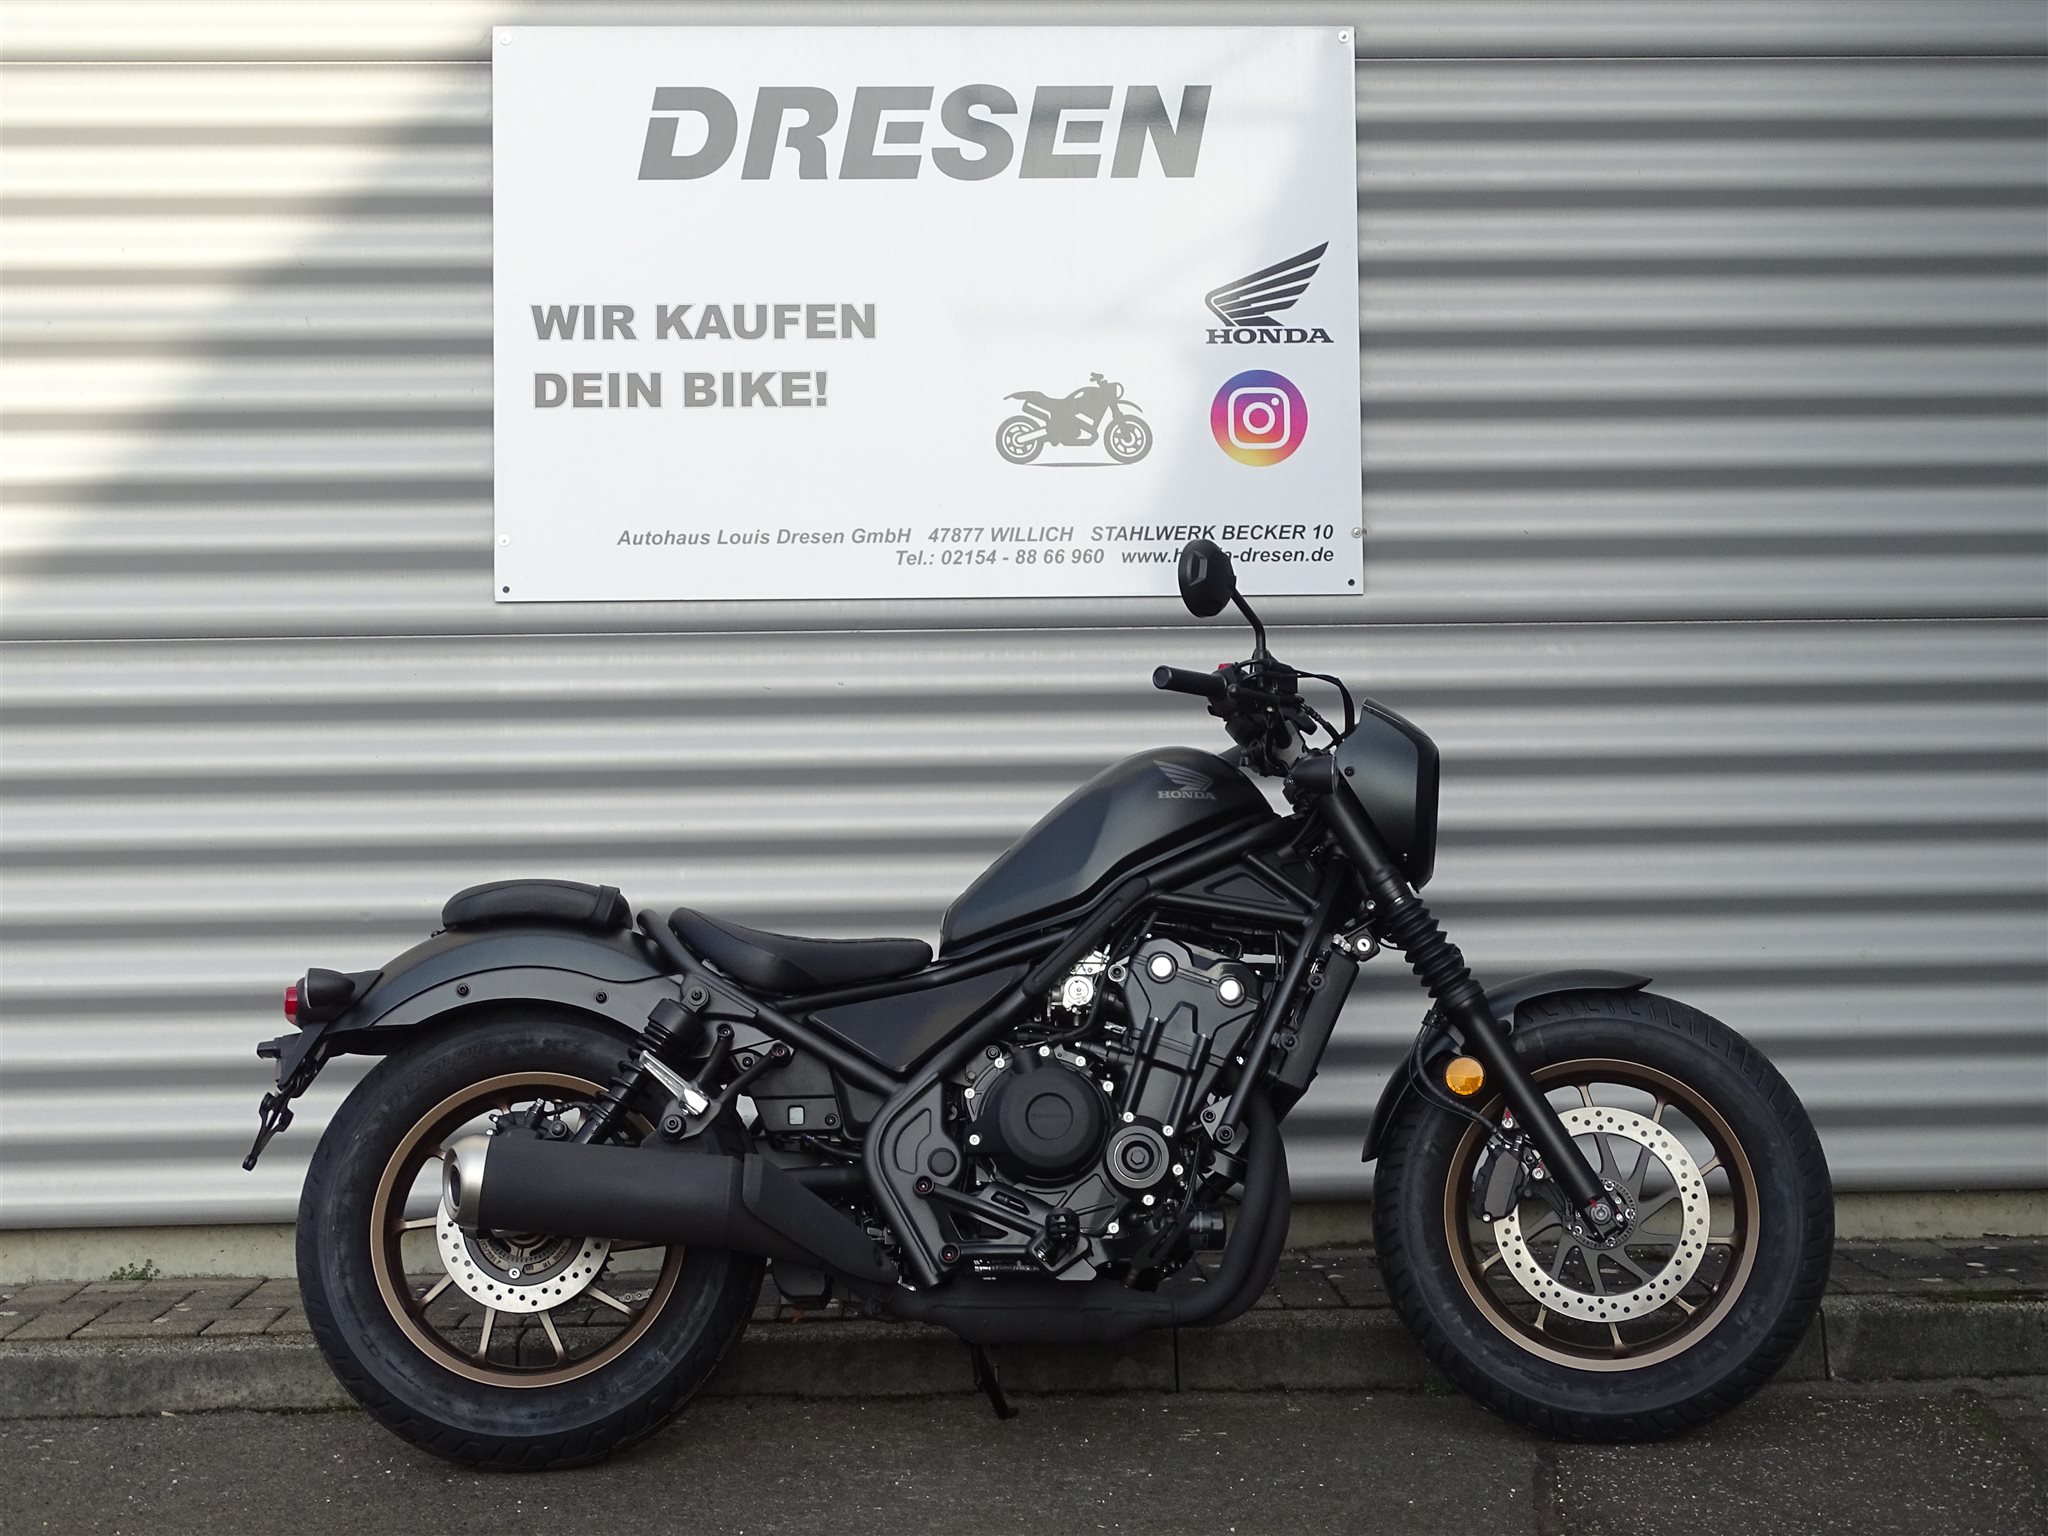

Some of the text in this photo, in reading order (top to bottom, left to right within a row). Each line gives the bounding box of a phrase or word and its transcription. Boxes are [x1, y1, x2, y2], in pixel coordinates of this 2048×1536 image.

[637, 84, 1212, 181] DRESEN
[531, 304, 876, 340] WIR KAUFEN
[1206, 328, 1334, 344] HONDA
[534, 370, 827, 408] DEIN BIKE!
[617, 524, 1334, 546] Autohaus Louis Dresen GmbH 47877 WILLICH STAHLWERK BECKER 10
[895, 550, 935, 565] Tel.:
[941, 549, 996, 565] 02154
[1015, 549, 1038, 564] 88
[1043, 549, 1066, 564] 66
[1071, 548, 1104, 564] 960
[1122, 547, 1334, 563] www.h-dresen.de
[1157, 790, 1216, 800] HONDA
